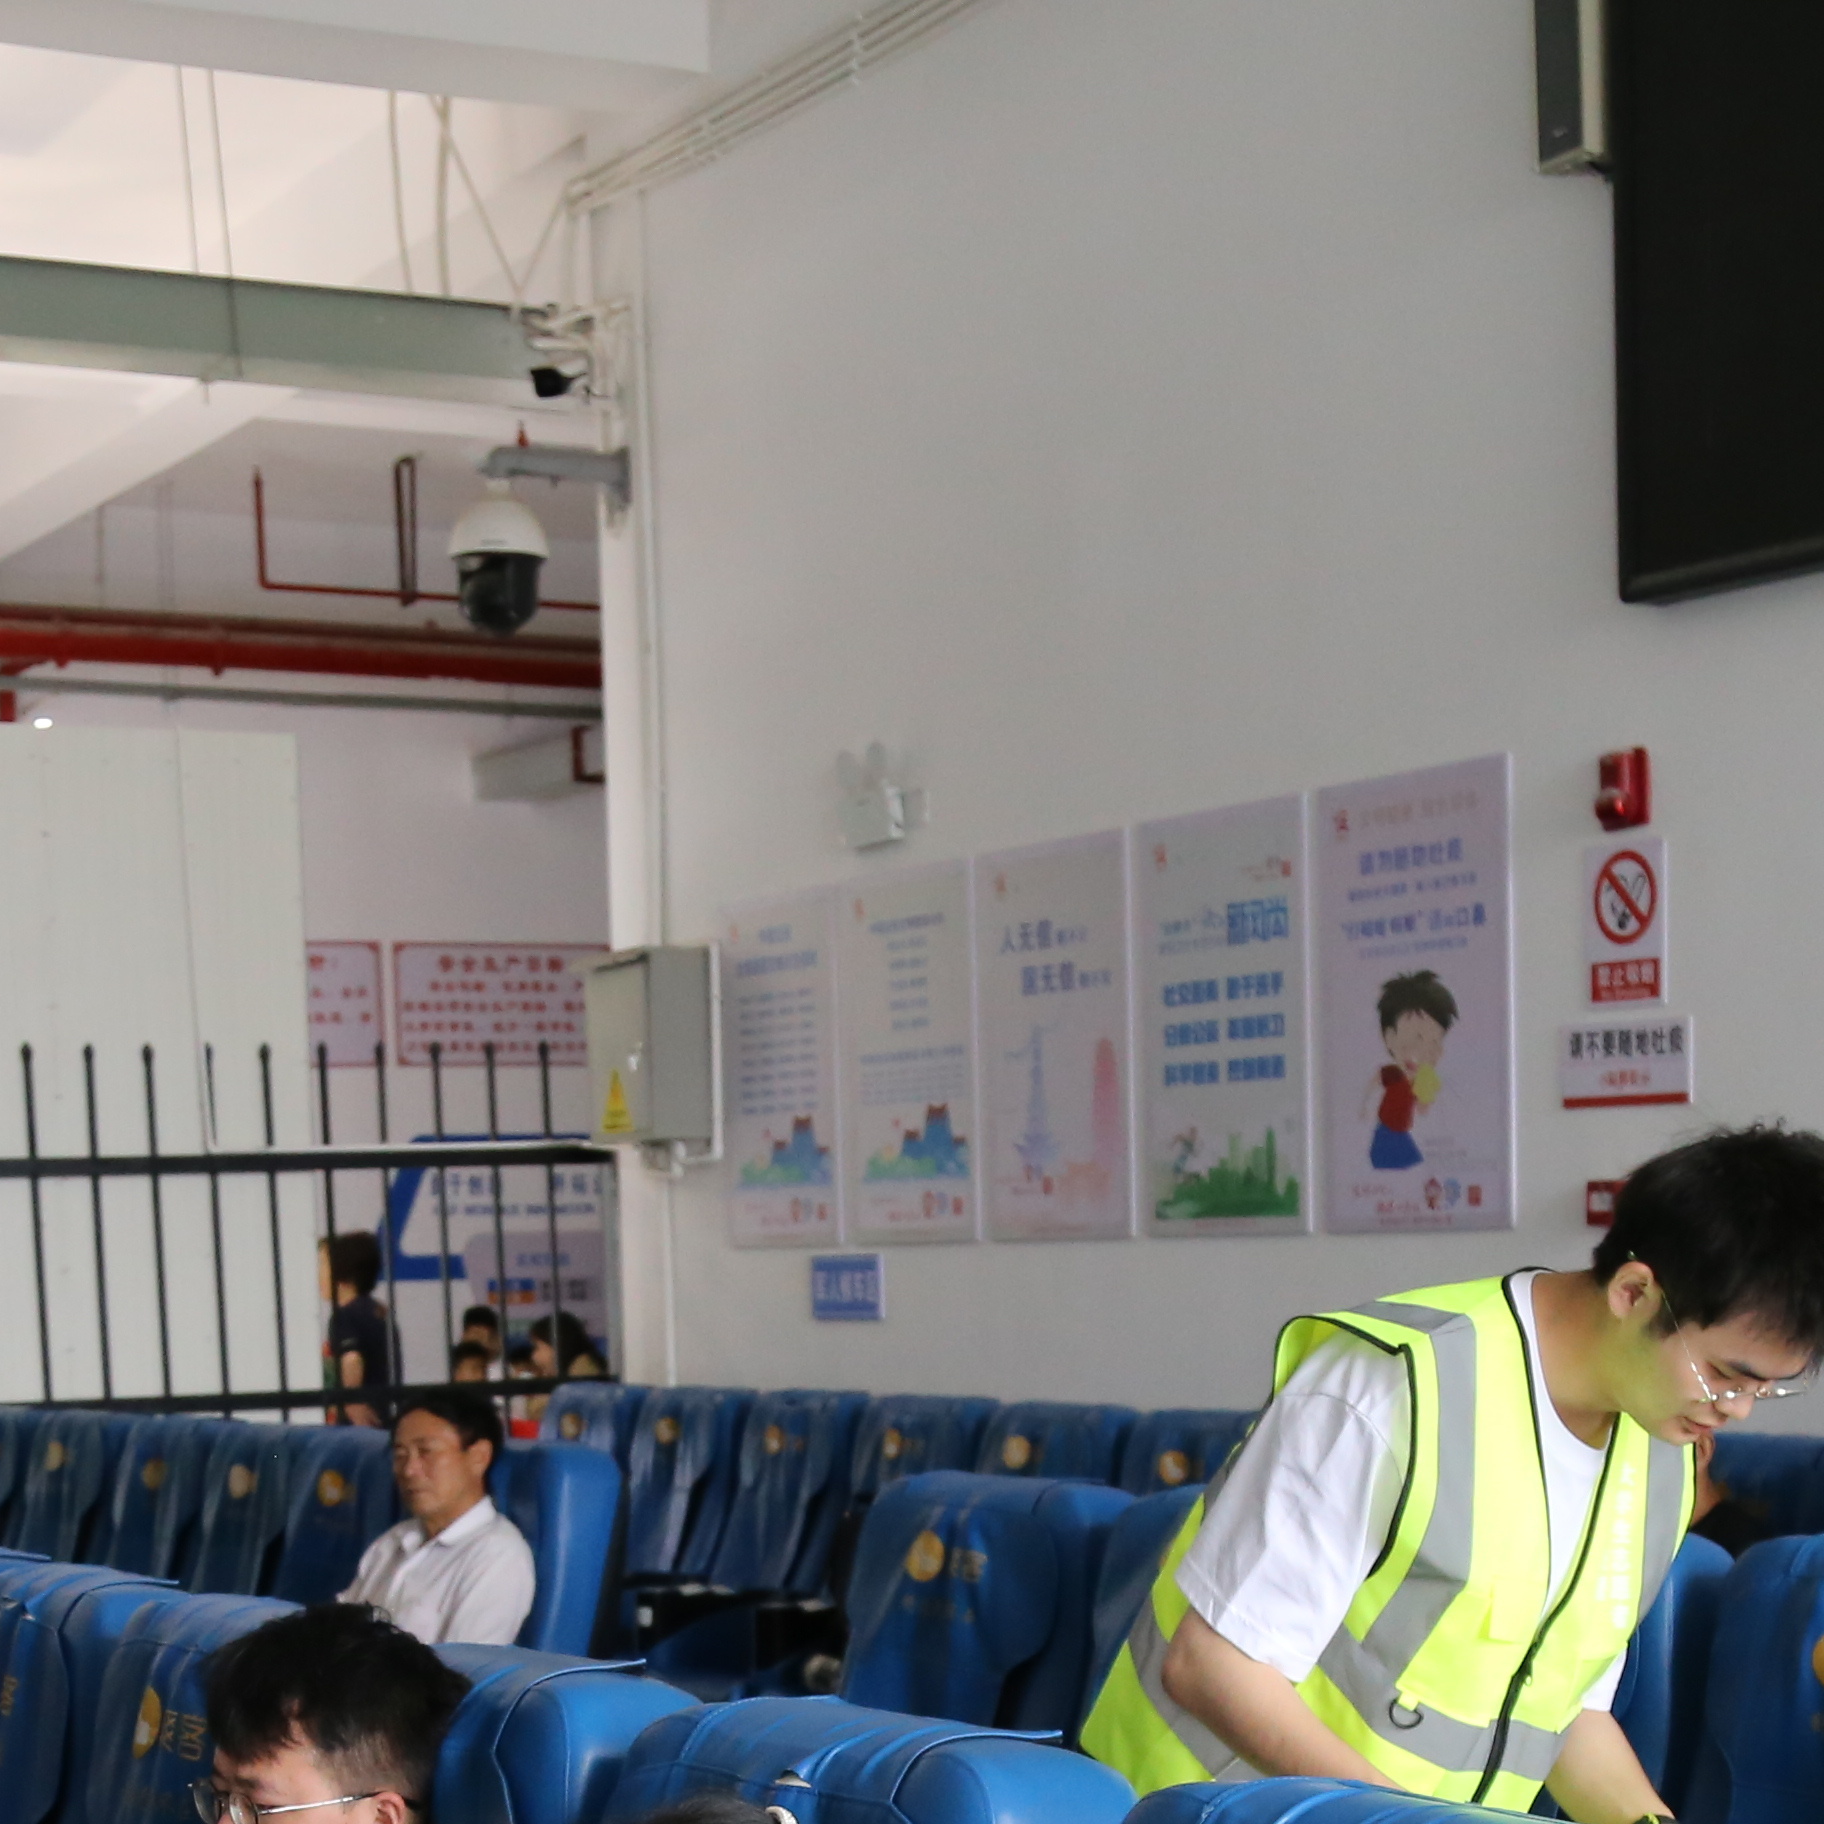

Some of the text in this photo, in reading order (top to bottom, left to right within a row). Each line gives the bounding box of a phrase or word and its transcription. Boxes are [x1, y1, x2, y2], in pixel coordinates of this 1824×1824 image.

[1569, 1024, 1684, 1060] 请不要随地吐痰
